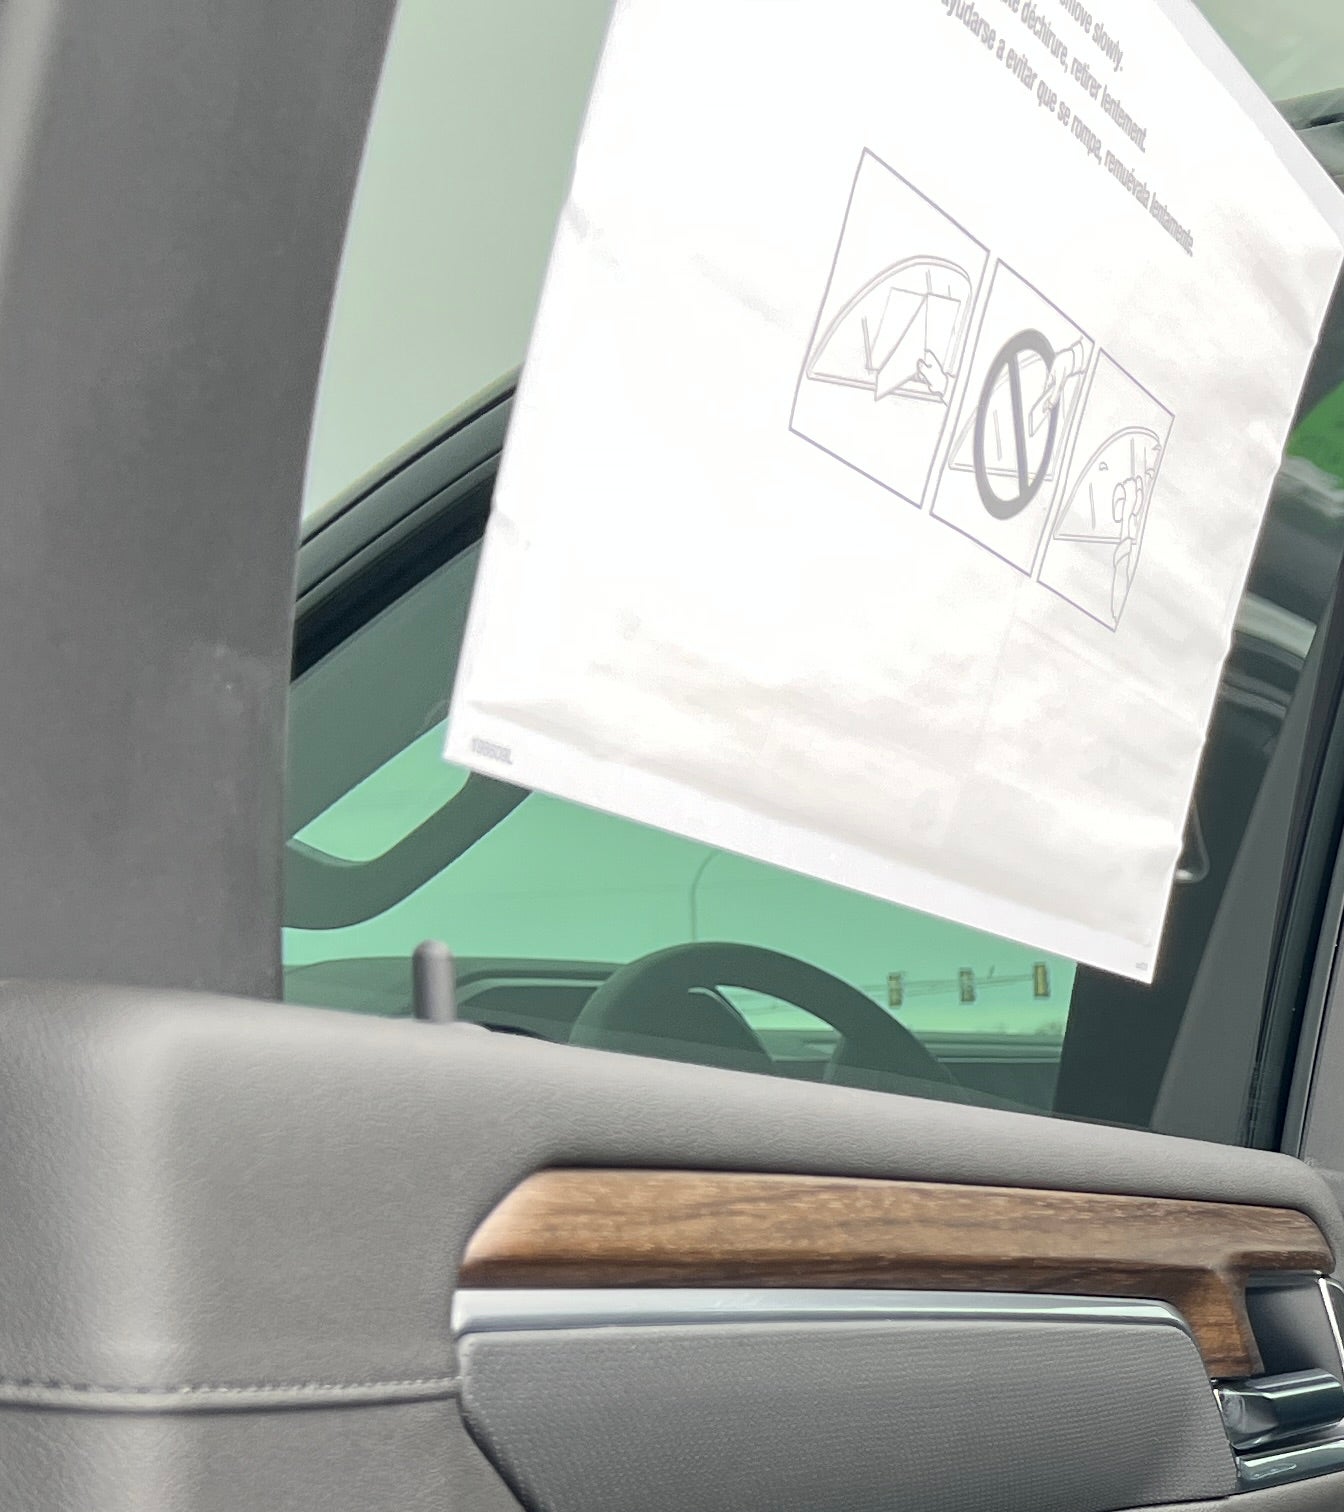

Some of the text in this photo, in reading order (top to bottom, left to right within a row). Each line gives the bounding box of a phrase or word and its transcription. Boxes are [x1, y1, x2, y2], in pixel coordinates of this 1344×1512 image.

[1021, 0, 1147, 153] déchirure, retirer lentement.
[1060, 0, 1124, 73] move slowly.
[996, 38, 1006, 61] a
[1006, 48, 1038, 91] evitar
[1036, 80, 1058, 112] que
[1057, 101, 1071, 126] se
[1070, 115, 1103, 165] rompa,
